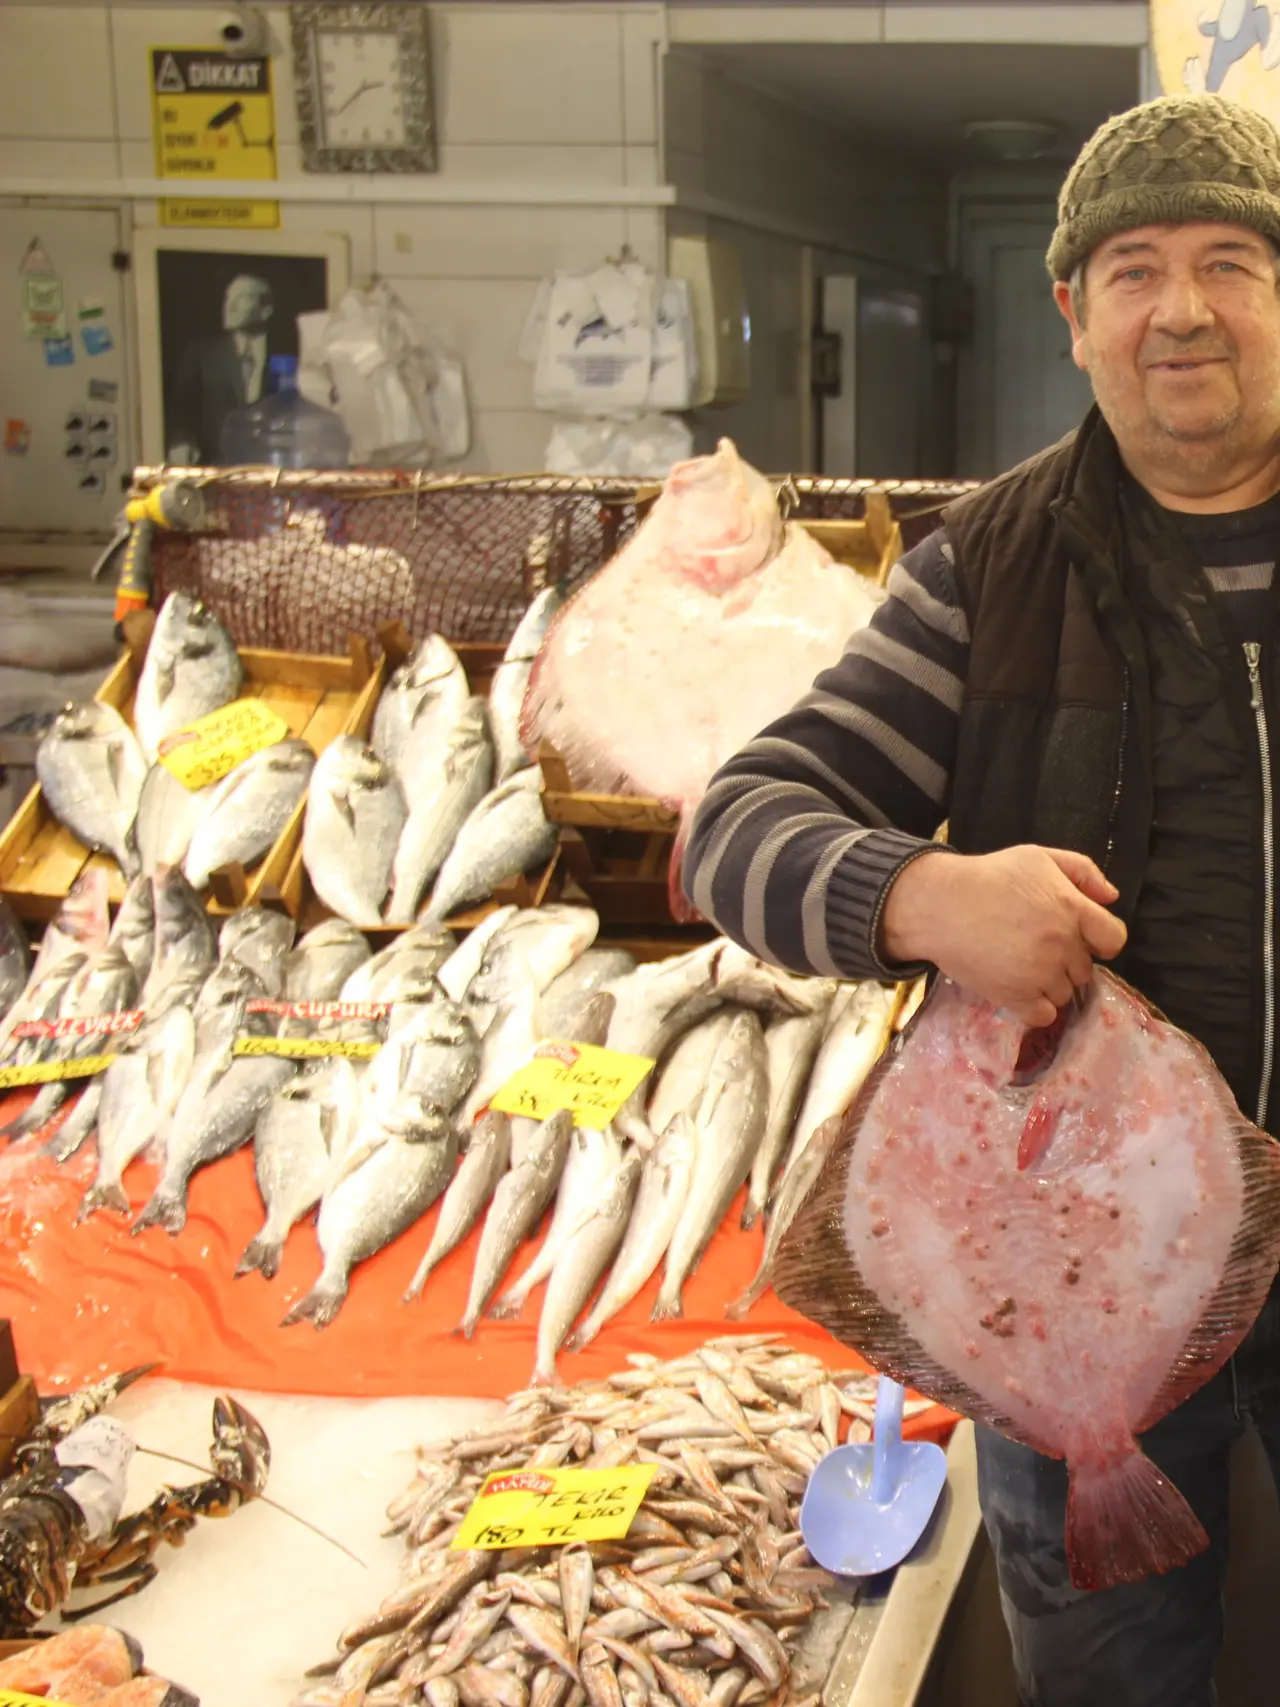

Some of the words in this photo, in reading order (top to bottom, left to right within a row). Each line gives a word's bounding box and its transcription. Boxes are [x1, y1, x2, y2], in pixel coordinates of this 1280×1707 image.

[188, 59, 262, 88] DİKKAT
[292, 1001, 387, 1019] ÇUPURA
[54, 1011, 138, 1038] LEVREK
[541, 1525, 578, 1538] TL
